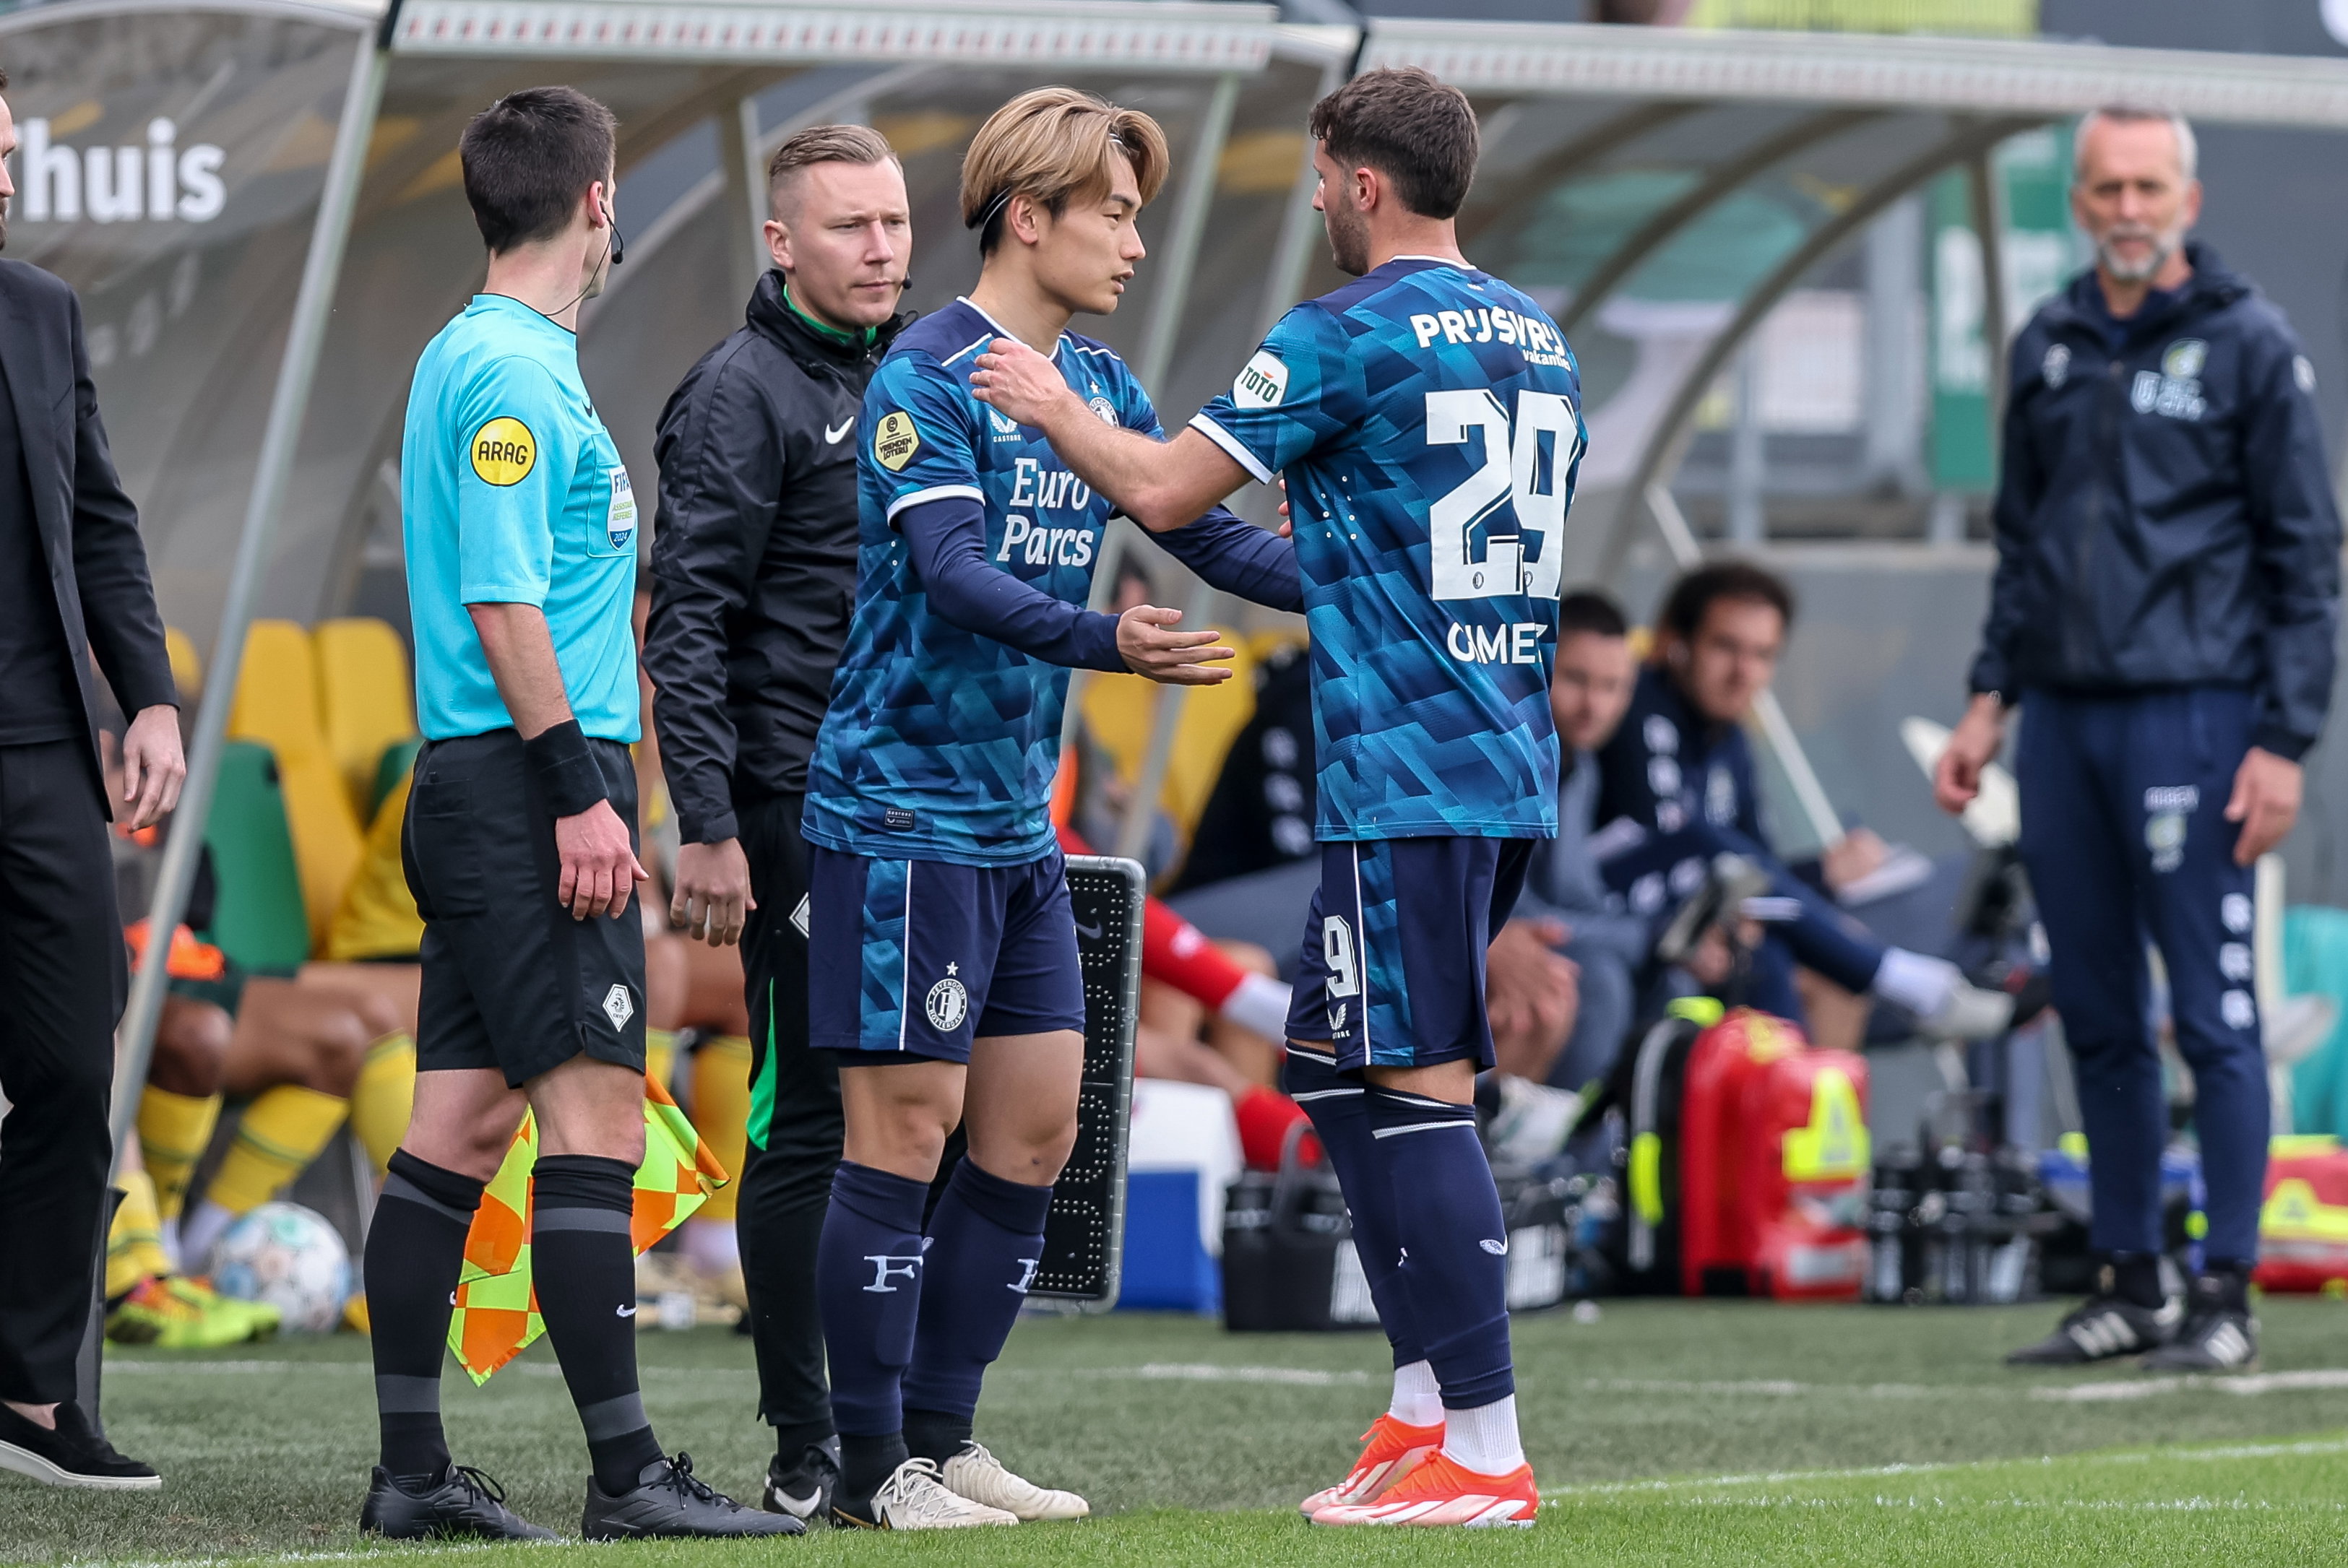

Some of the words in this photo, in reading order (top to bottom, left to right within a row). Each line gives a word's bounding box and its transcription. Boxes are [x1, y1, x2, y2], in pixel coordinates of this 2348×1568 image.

[5, 116, 228, 225] huis
[1240, 366, 1278, 403] TOTO
[478, 440, 528, 465] ARAG
[1009, 457, 1090, 511] Euro
[1425, 389, 1581, 601] 29
[613, 532, 628, 542] 2024
[996, 514, 1094, 567] Parcs
[1323, 915, 1360, 998] 9
[863, 1255, 923, 1293] F
